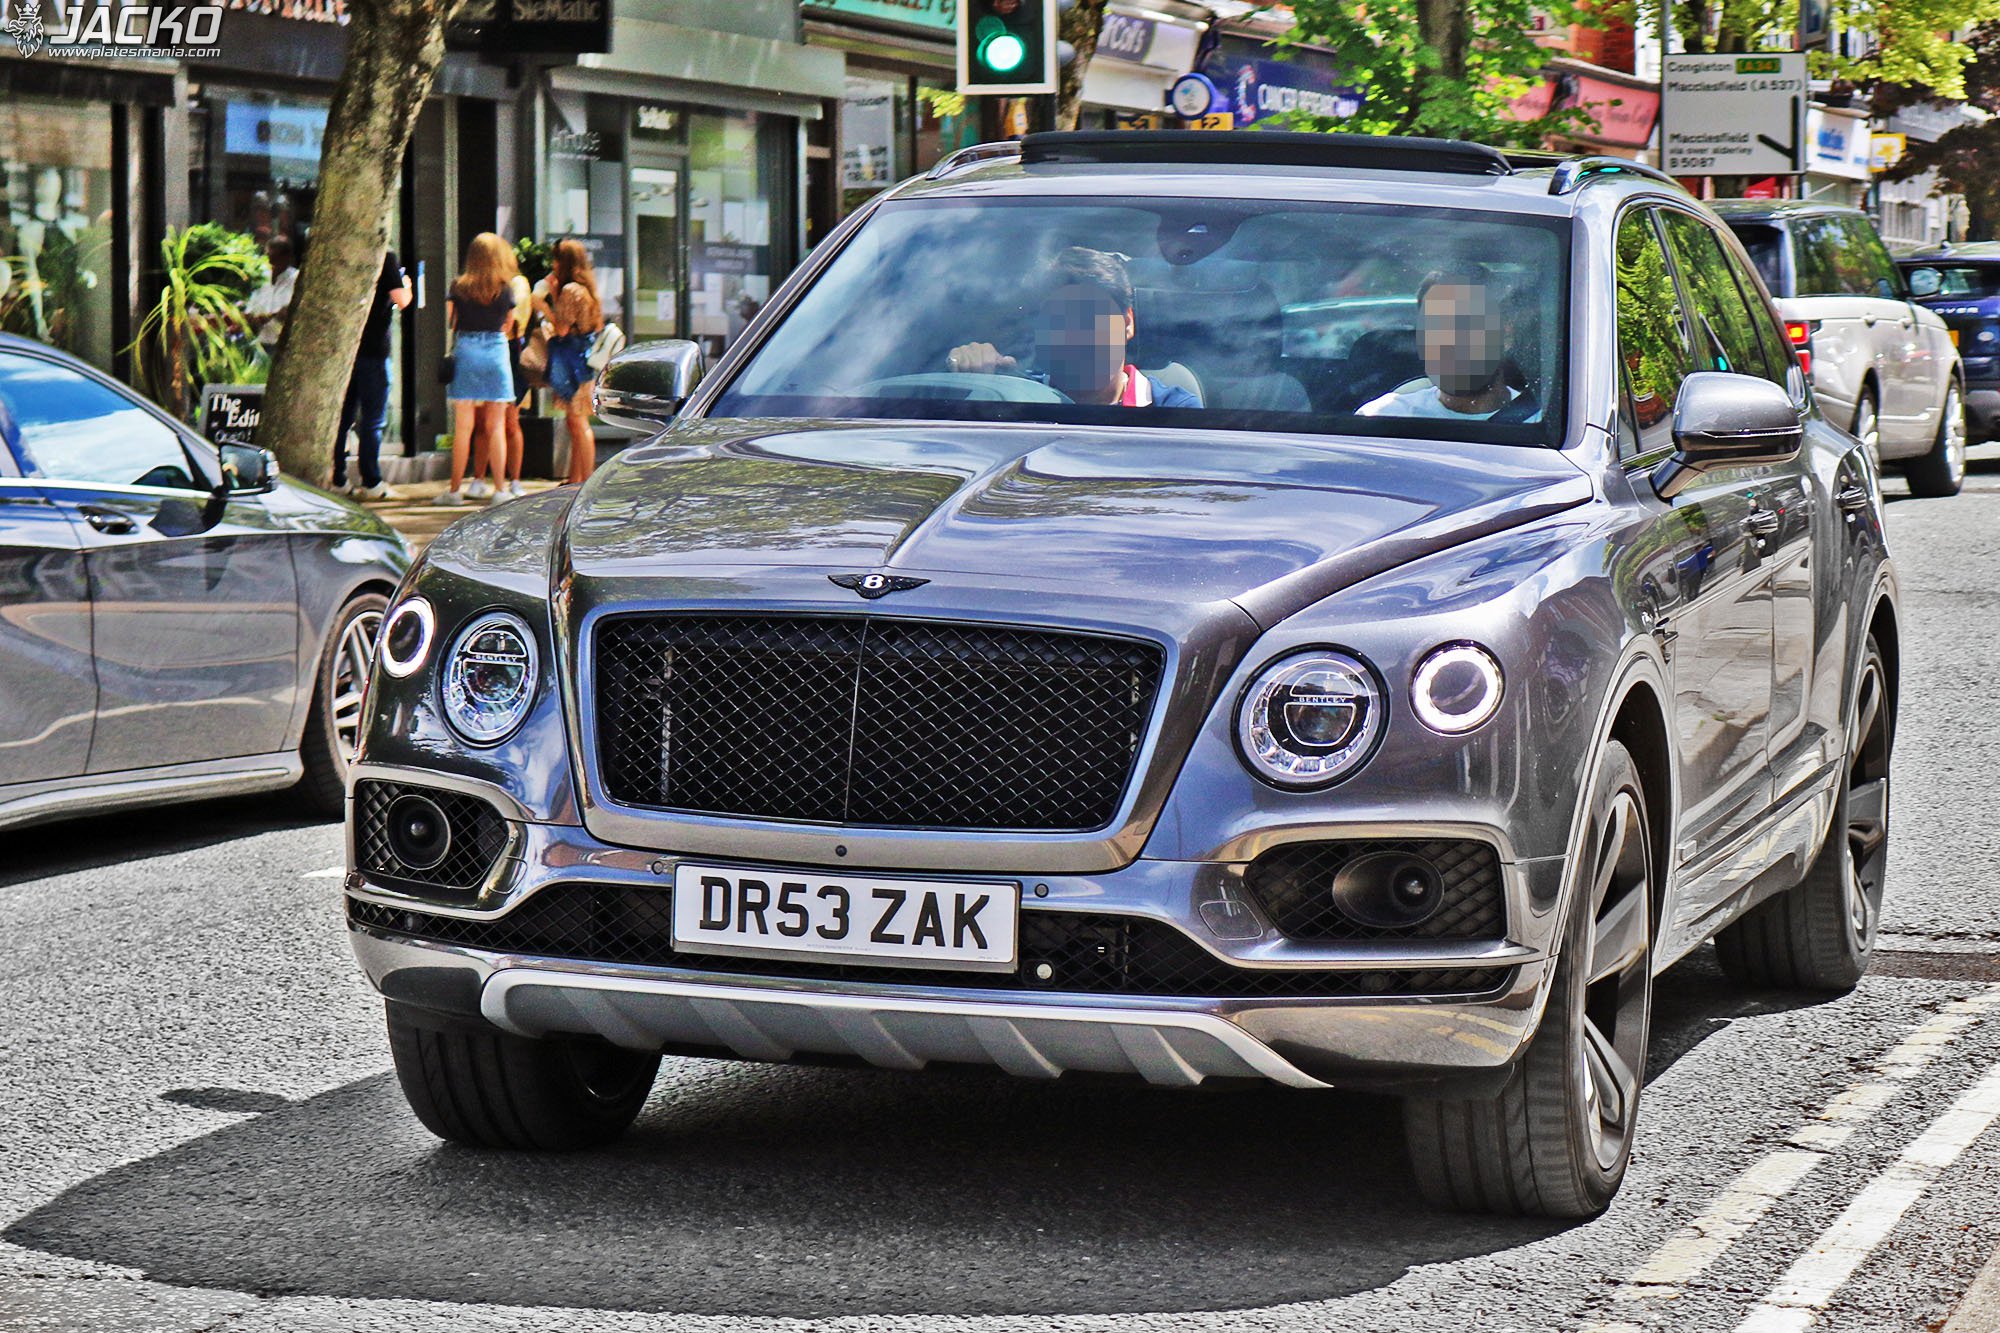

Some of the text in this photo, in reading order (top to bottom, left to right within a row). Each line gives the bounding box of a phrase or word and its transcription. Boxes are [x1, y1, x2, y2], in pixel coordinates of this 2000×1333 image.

[1667, 61, 1732, 73] Congleton
[1667, 81, 1748, 92] Macclesfield
[1669, 132, 1749, 143] Macclesfield
[1933, 307, 1979, 315] OVER
[209, 393, 242, 411] The
[700, 875, 990, 949] DR53 ZAK
